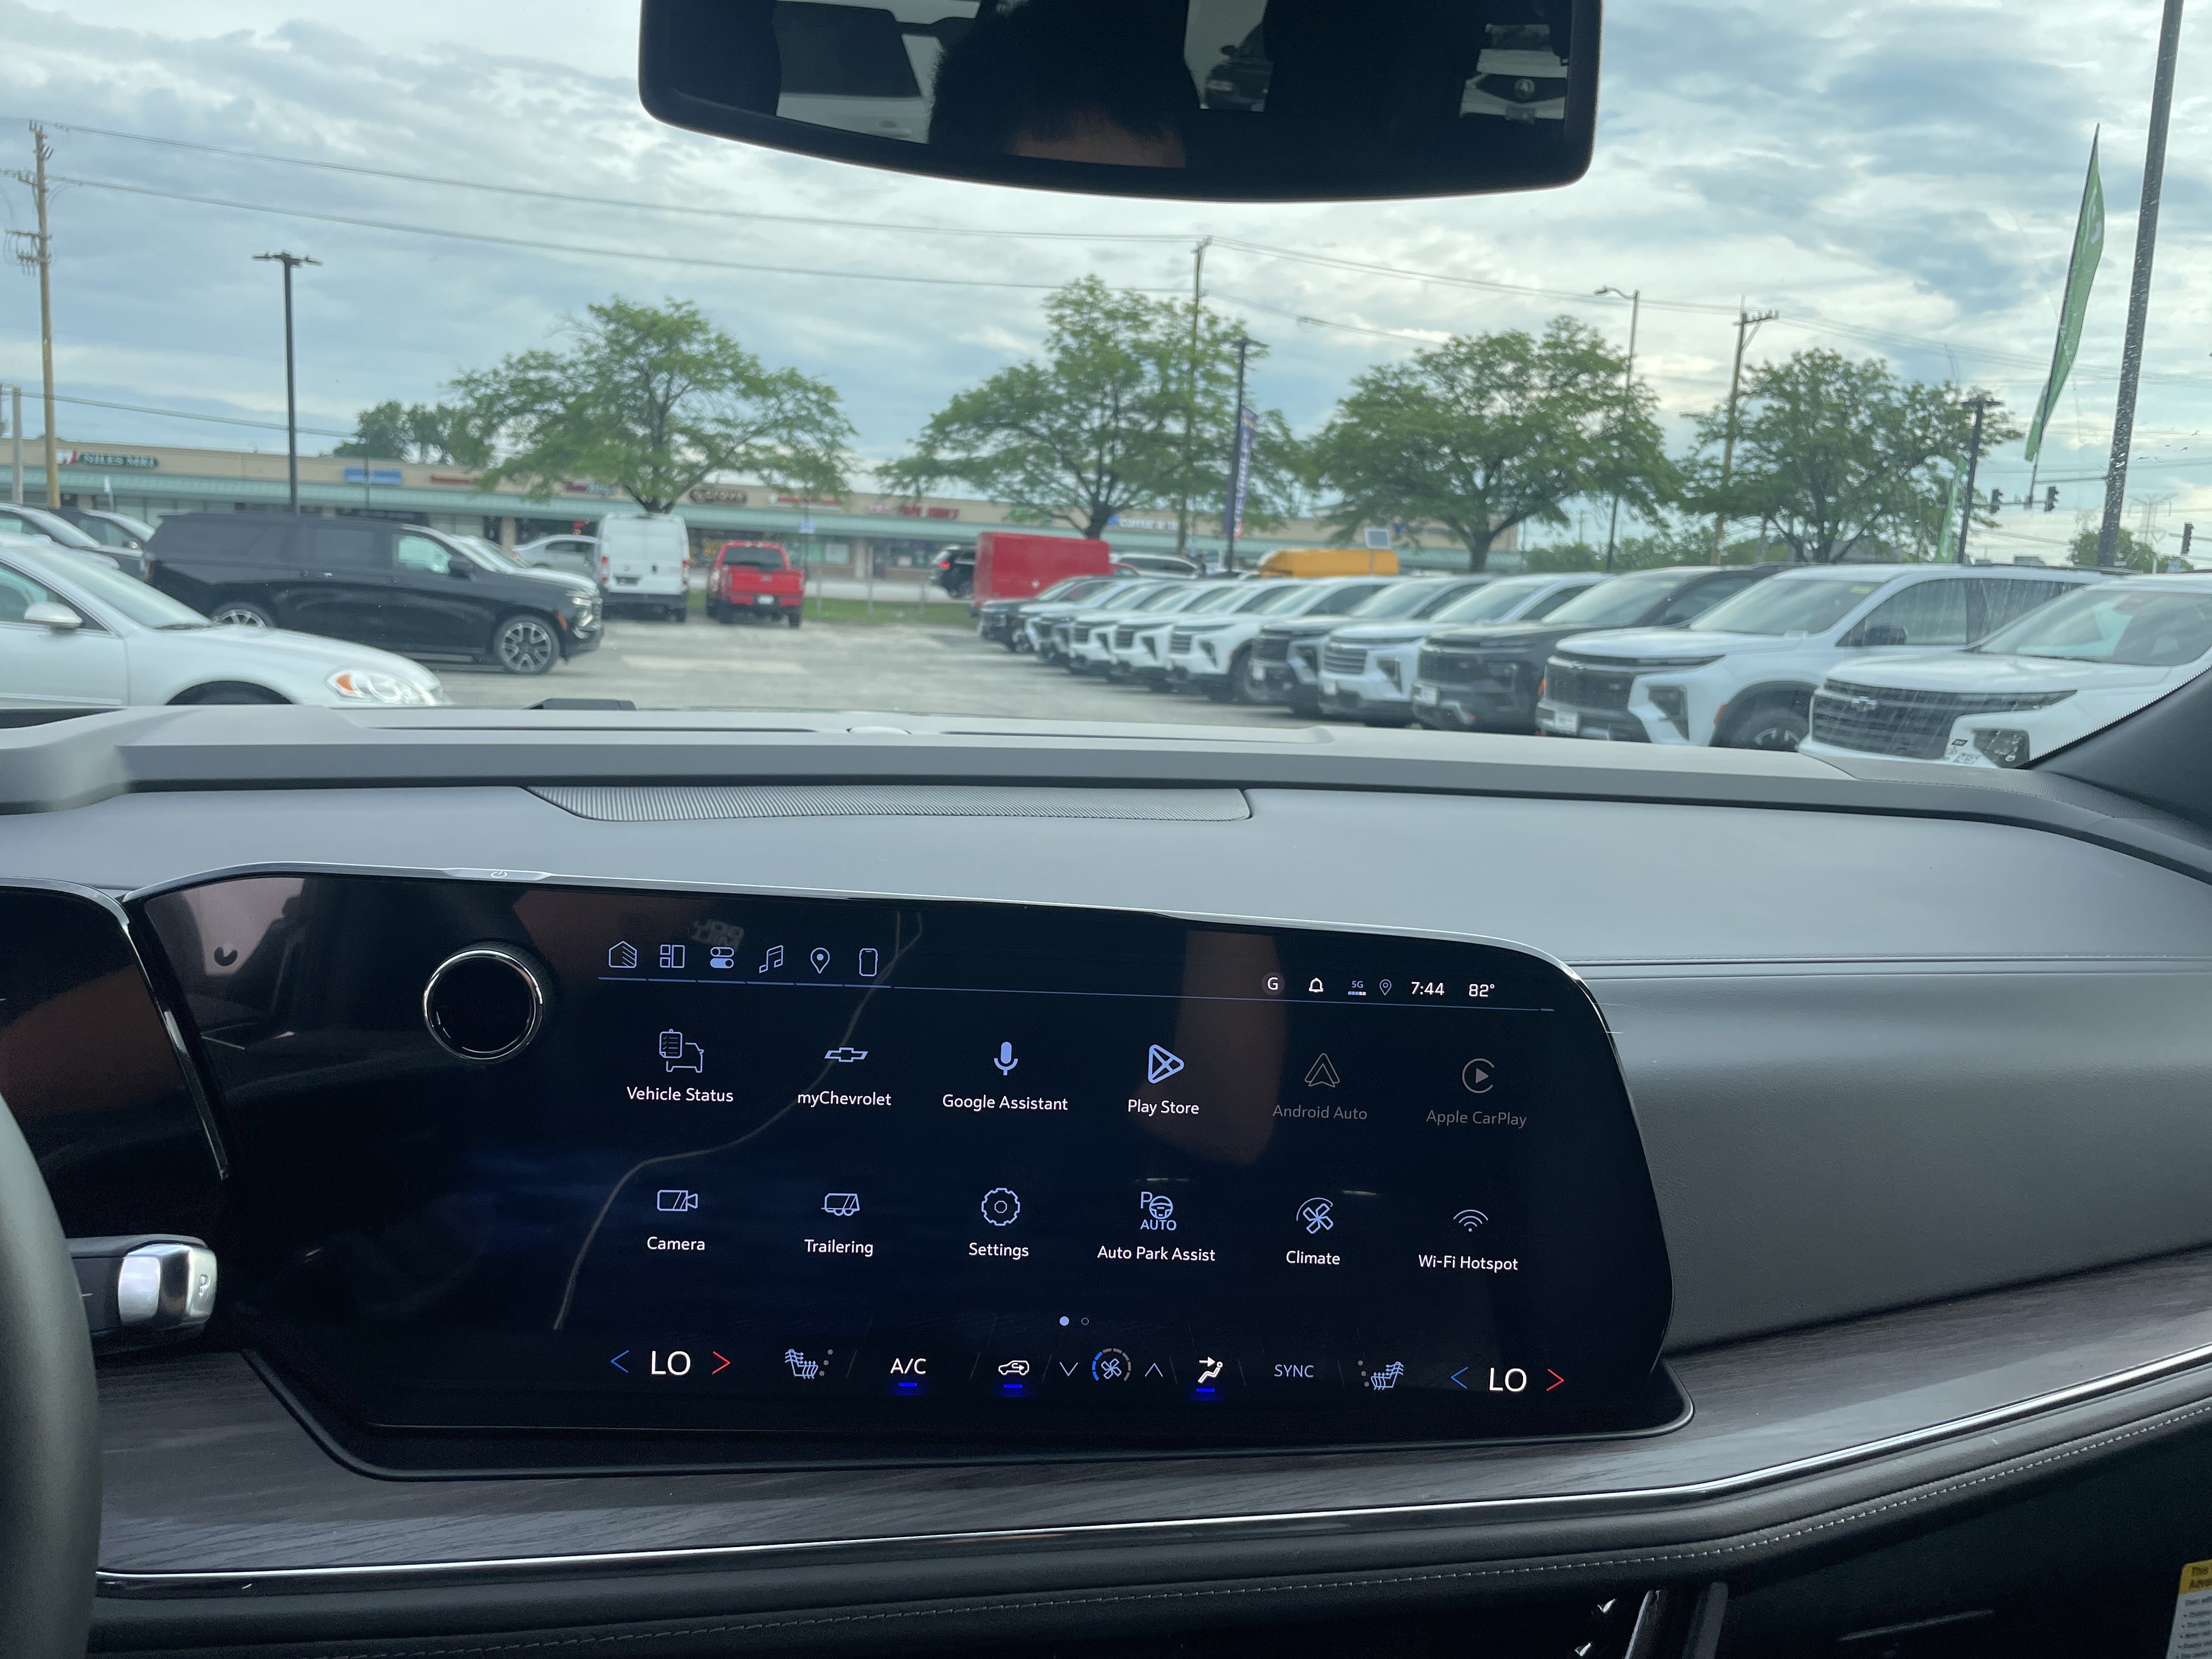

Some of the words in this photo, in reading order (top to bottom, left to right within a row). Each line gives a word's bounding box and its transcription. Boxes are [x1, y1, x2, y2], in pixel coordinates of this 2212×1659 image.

[1267, 977, 1278, 990] G
[1351, 980, 1364, 989] 5G
[1411, 981, 1444, 996] 7:44
[1469, 984, 1495, 997] 82°
[627, 1086, 681, 1101] Vehicle
[685, 1087, 733, 1102] Status
[798, 1090, 891, 1108] myChevrolet
[943, 1094, 995, 1112] Google
[998, 1096, 1068, 1110] Assistant
[1128, 1099, 1158, 1116] Play
[1160, 1100, 1199, 1114] Store
[1272, 1104, 1329, 1119] Android
[1333, 1106, 1367, 1120] Auto
[1426, 1110, 1468, 1126] Apple
[1472, 1111, 1527, 1129] CarPlay
[1140, 1191, 1153, 1209] P
[1140, 1218, 1177, 1231] AUTO
[647, 1236, 705, 1250] Camera
[804, 1239, 873, 1257] Trailering
[968, 1242, 1029, 1260] Settings
[1097, 1245, 1132, 1259] Auto
[1136, 1246, 1169, 1260] Park
[1171, 1247, 1216, 1261] Assist
[1286, 1250, 1340, 1265] Climate
[1418, 1254, 1455, 1268] Wi-Fi
[1460, 1256, 1518, 1273] Hotspot
[651, 1350, 691, 1375] LO
[890, 1358, 927, 1374] A/C
[1274, 1364, 1314, 1378] SYNC
[1489, 1367, 1527, 1392] LO
